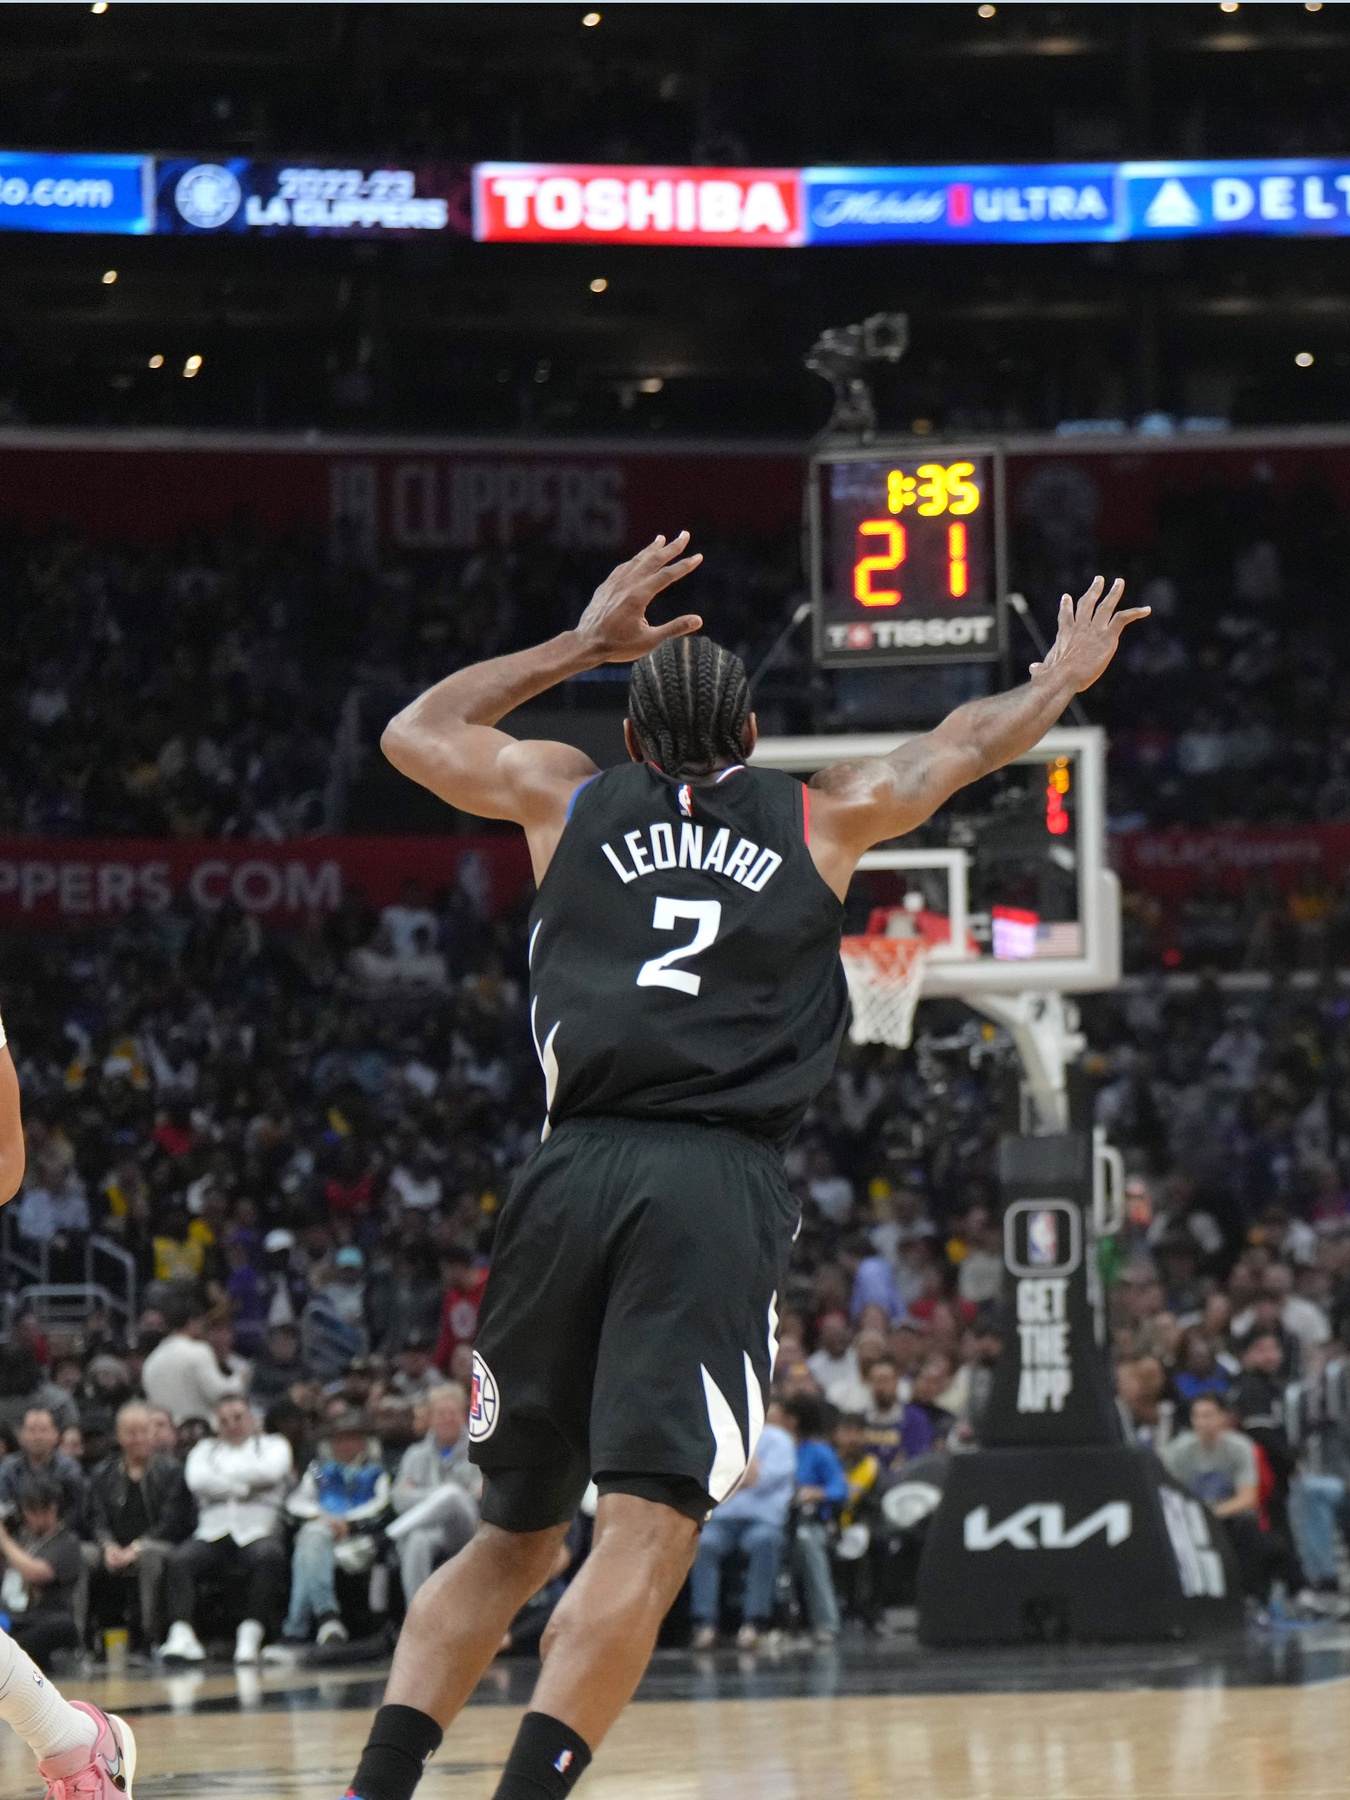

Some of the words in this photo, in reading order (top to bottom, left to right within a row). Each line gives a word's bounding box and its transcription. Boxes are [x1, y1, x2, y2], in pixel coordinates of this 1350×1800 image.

[0, 172, 114, 208] o.com
[493, 177, 790, 233] TOSHIBA
[973, 185, 1108, 223] ULTRA
[887, 461, 981, 517] 1:35
[873, 616, 995, 649] TISSOT
[601, 822, 783, 892] LEONARD
[636, 896, 722, 996] 2
